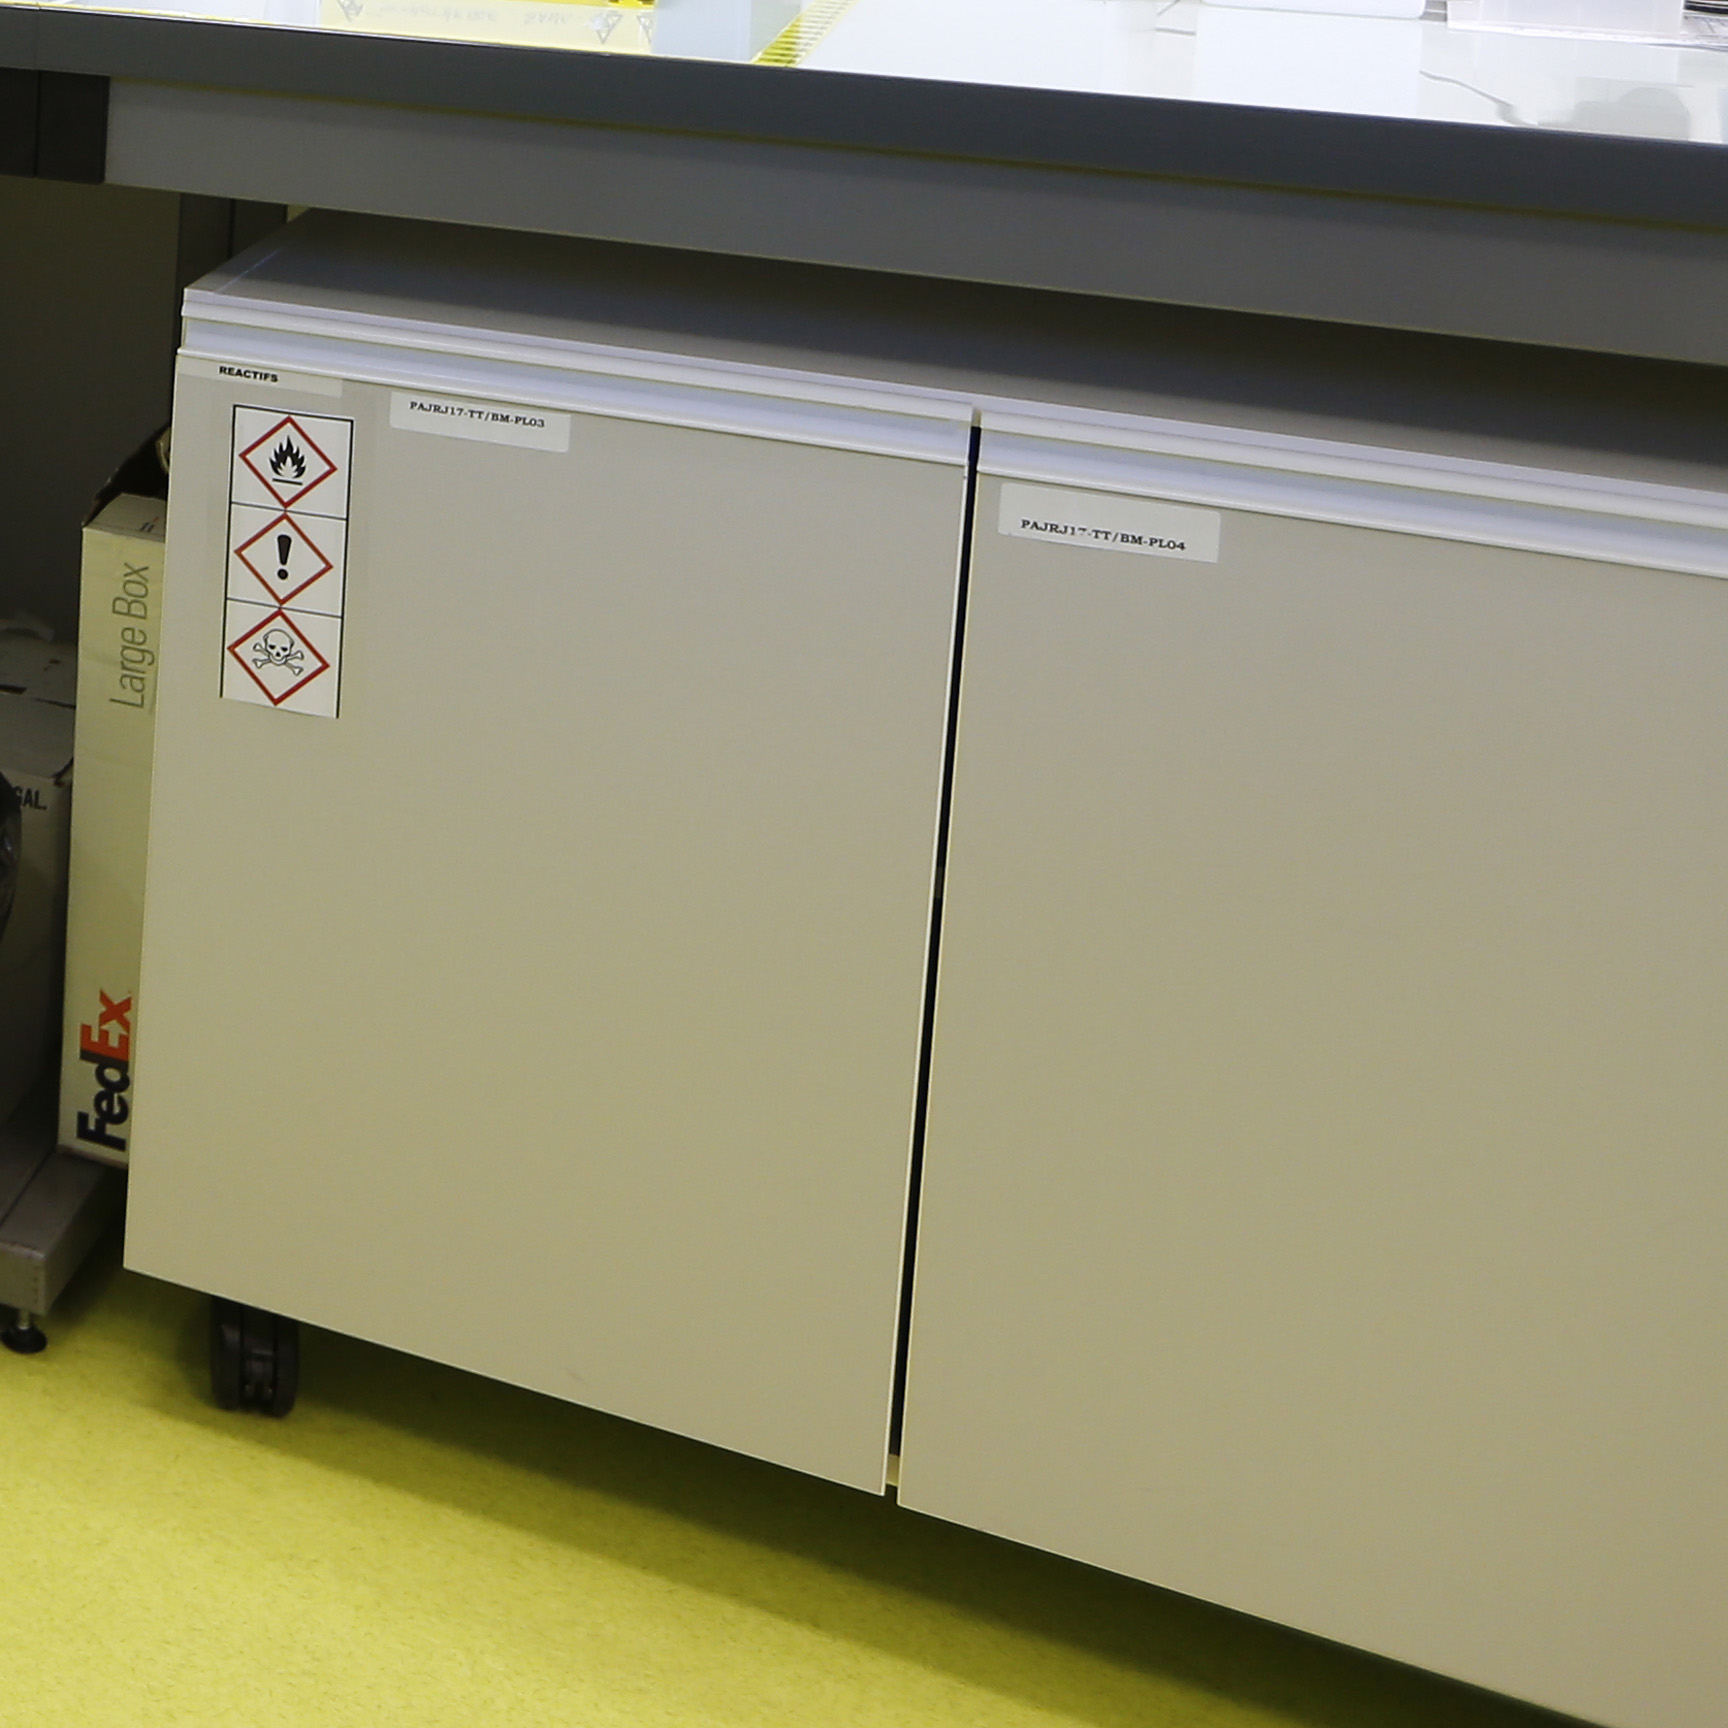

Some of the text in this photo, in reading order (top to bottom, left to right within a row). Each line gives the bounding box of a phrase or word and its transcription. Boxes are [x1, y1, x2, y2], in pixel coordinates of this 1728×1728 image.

[219, 365, 278, 383] REACTIFS
[110, 562, 155, 708] Large Box
[77, 988, 134, 1150] FedEx
